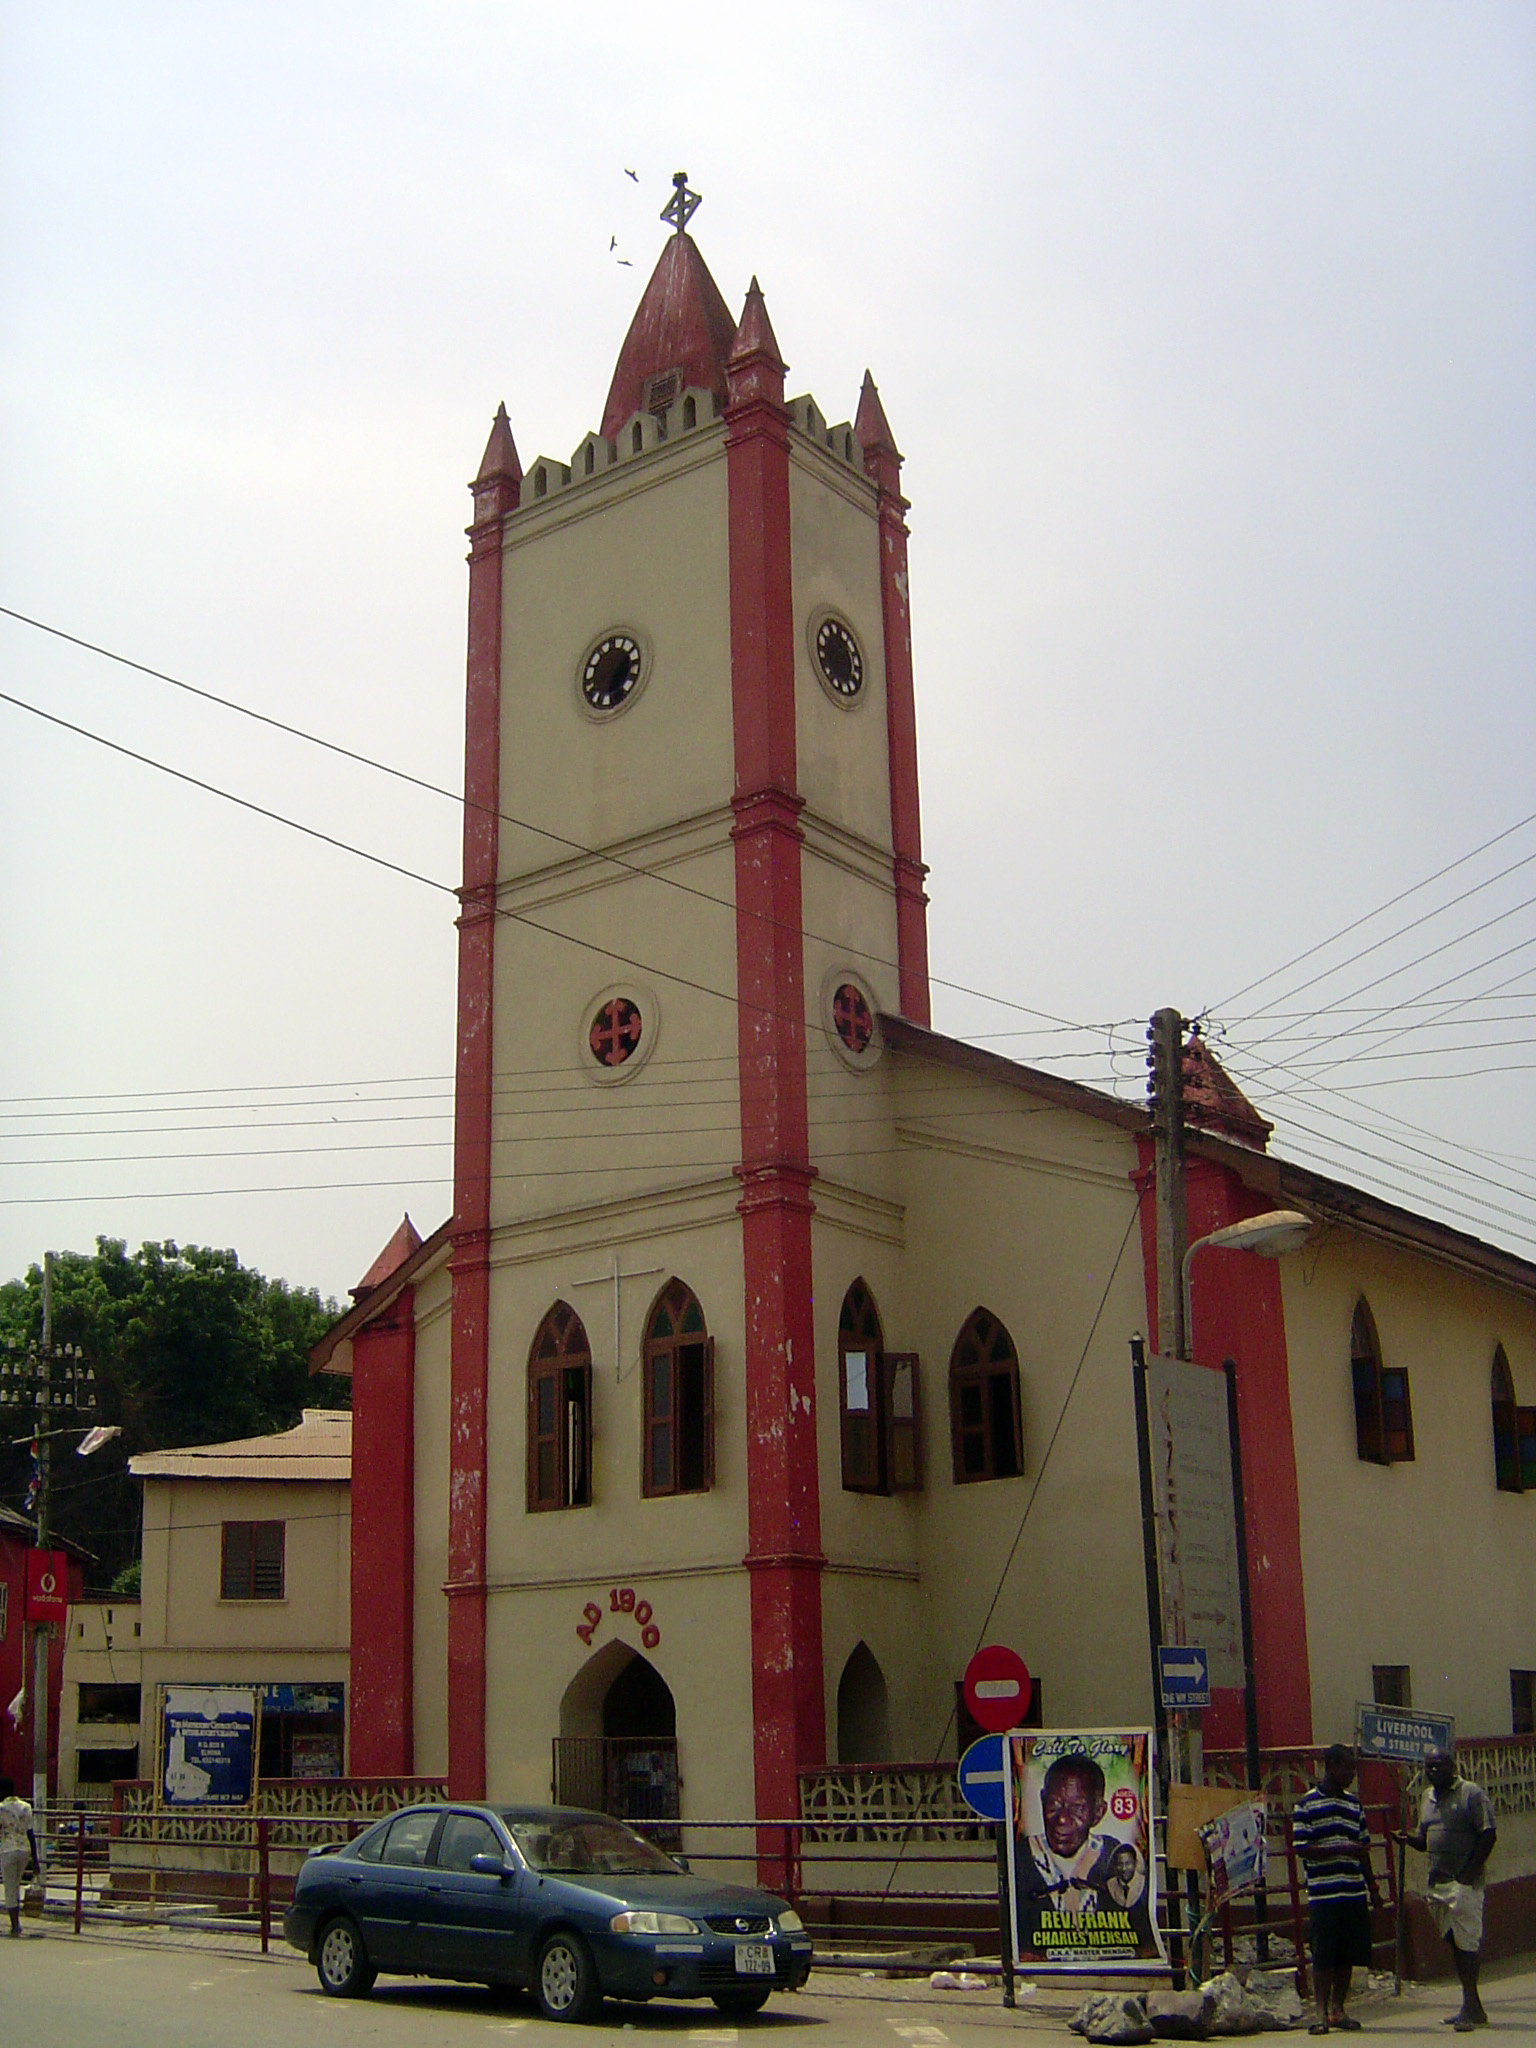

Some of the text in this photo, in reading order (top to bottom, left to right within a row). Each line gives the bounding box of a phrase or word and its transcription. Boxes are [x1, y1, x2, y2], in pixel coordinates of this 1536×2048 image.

[1377, 1720, 1433, 1739] LIVERPOOL
[1032, 1740, 1129, 1757] Call To Glory
[1388, 1739, 1420, 1752] STREET
[1114, 1798, 1134, 1814] 83
[1041, 1911, 1131, 1929] REV. FRANK
[1033, 1931, 1139, 1945] CHARLES MENSAH
[746, 1946, 762, 1958] CR
